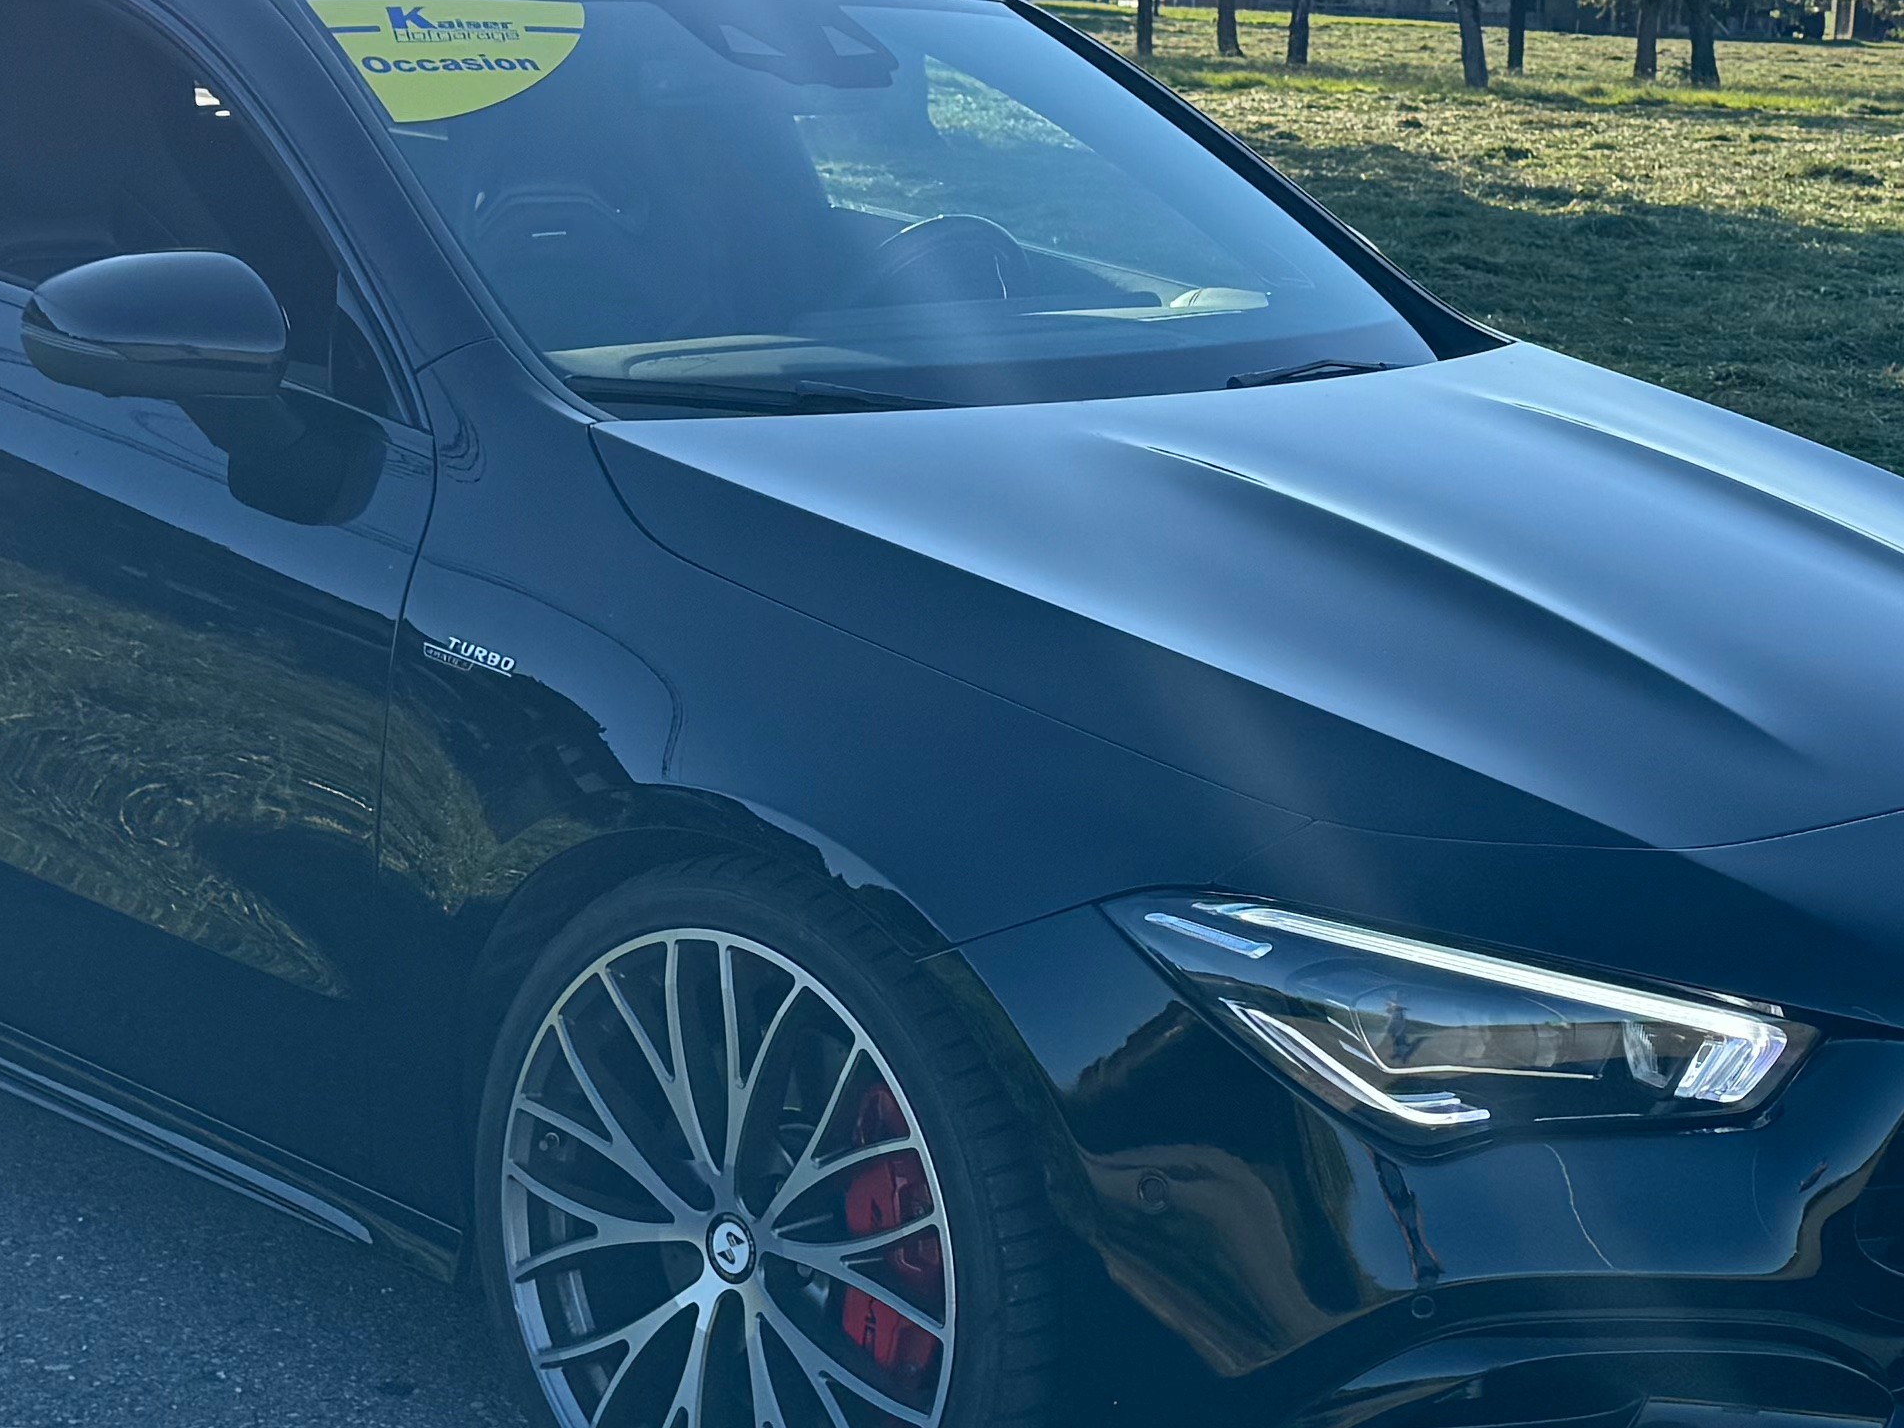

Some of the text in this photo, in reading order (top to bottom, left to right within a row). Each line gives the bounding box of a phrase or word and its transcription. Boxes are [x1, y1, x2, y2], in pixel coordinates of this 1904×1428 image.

[386, 6, 513, 29] Kaiser
[361, 54, 541, 74] Occasion
[448, 636, 515, 671] TURBO
